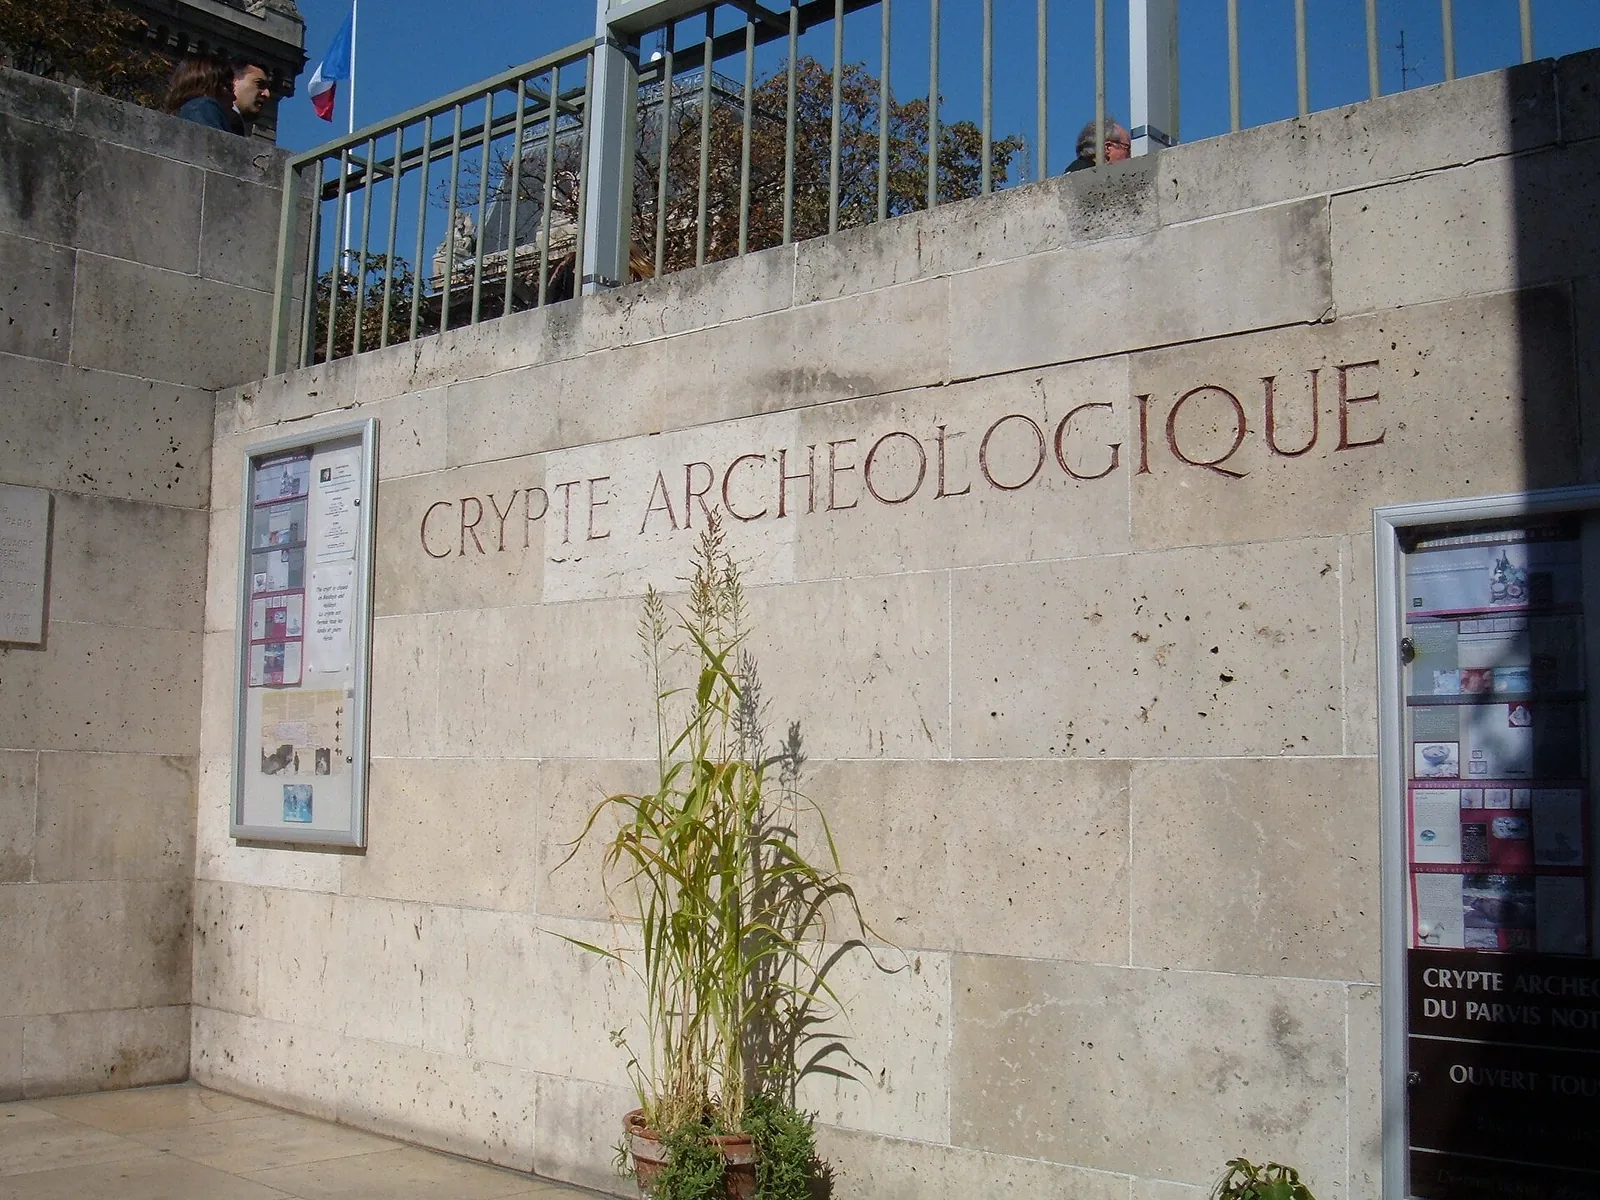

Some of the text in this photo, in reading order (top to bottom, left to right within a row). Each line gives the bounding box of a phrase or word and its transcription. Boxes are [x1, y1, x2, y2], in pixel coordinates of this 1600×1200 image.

[420, 360, 1386, 559] CRYPTE ARCHEOLOGIQUE
[1422, 967, 1504, 992] CRYPTE
[1423, 998, 1457, 1020] DU
[1465, 1001, 1542, 1026] PARVIS
[1449, 1064, 1600, 1097] OUVERT TOU
